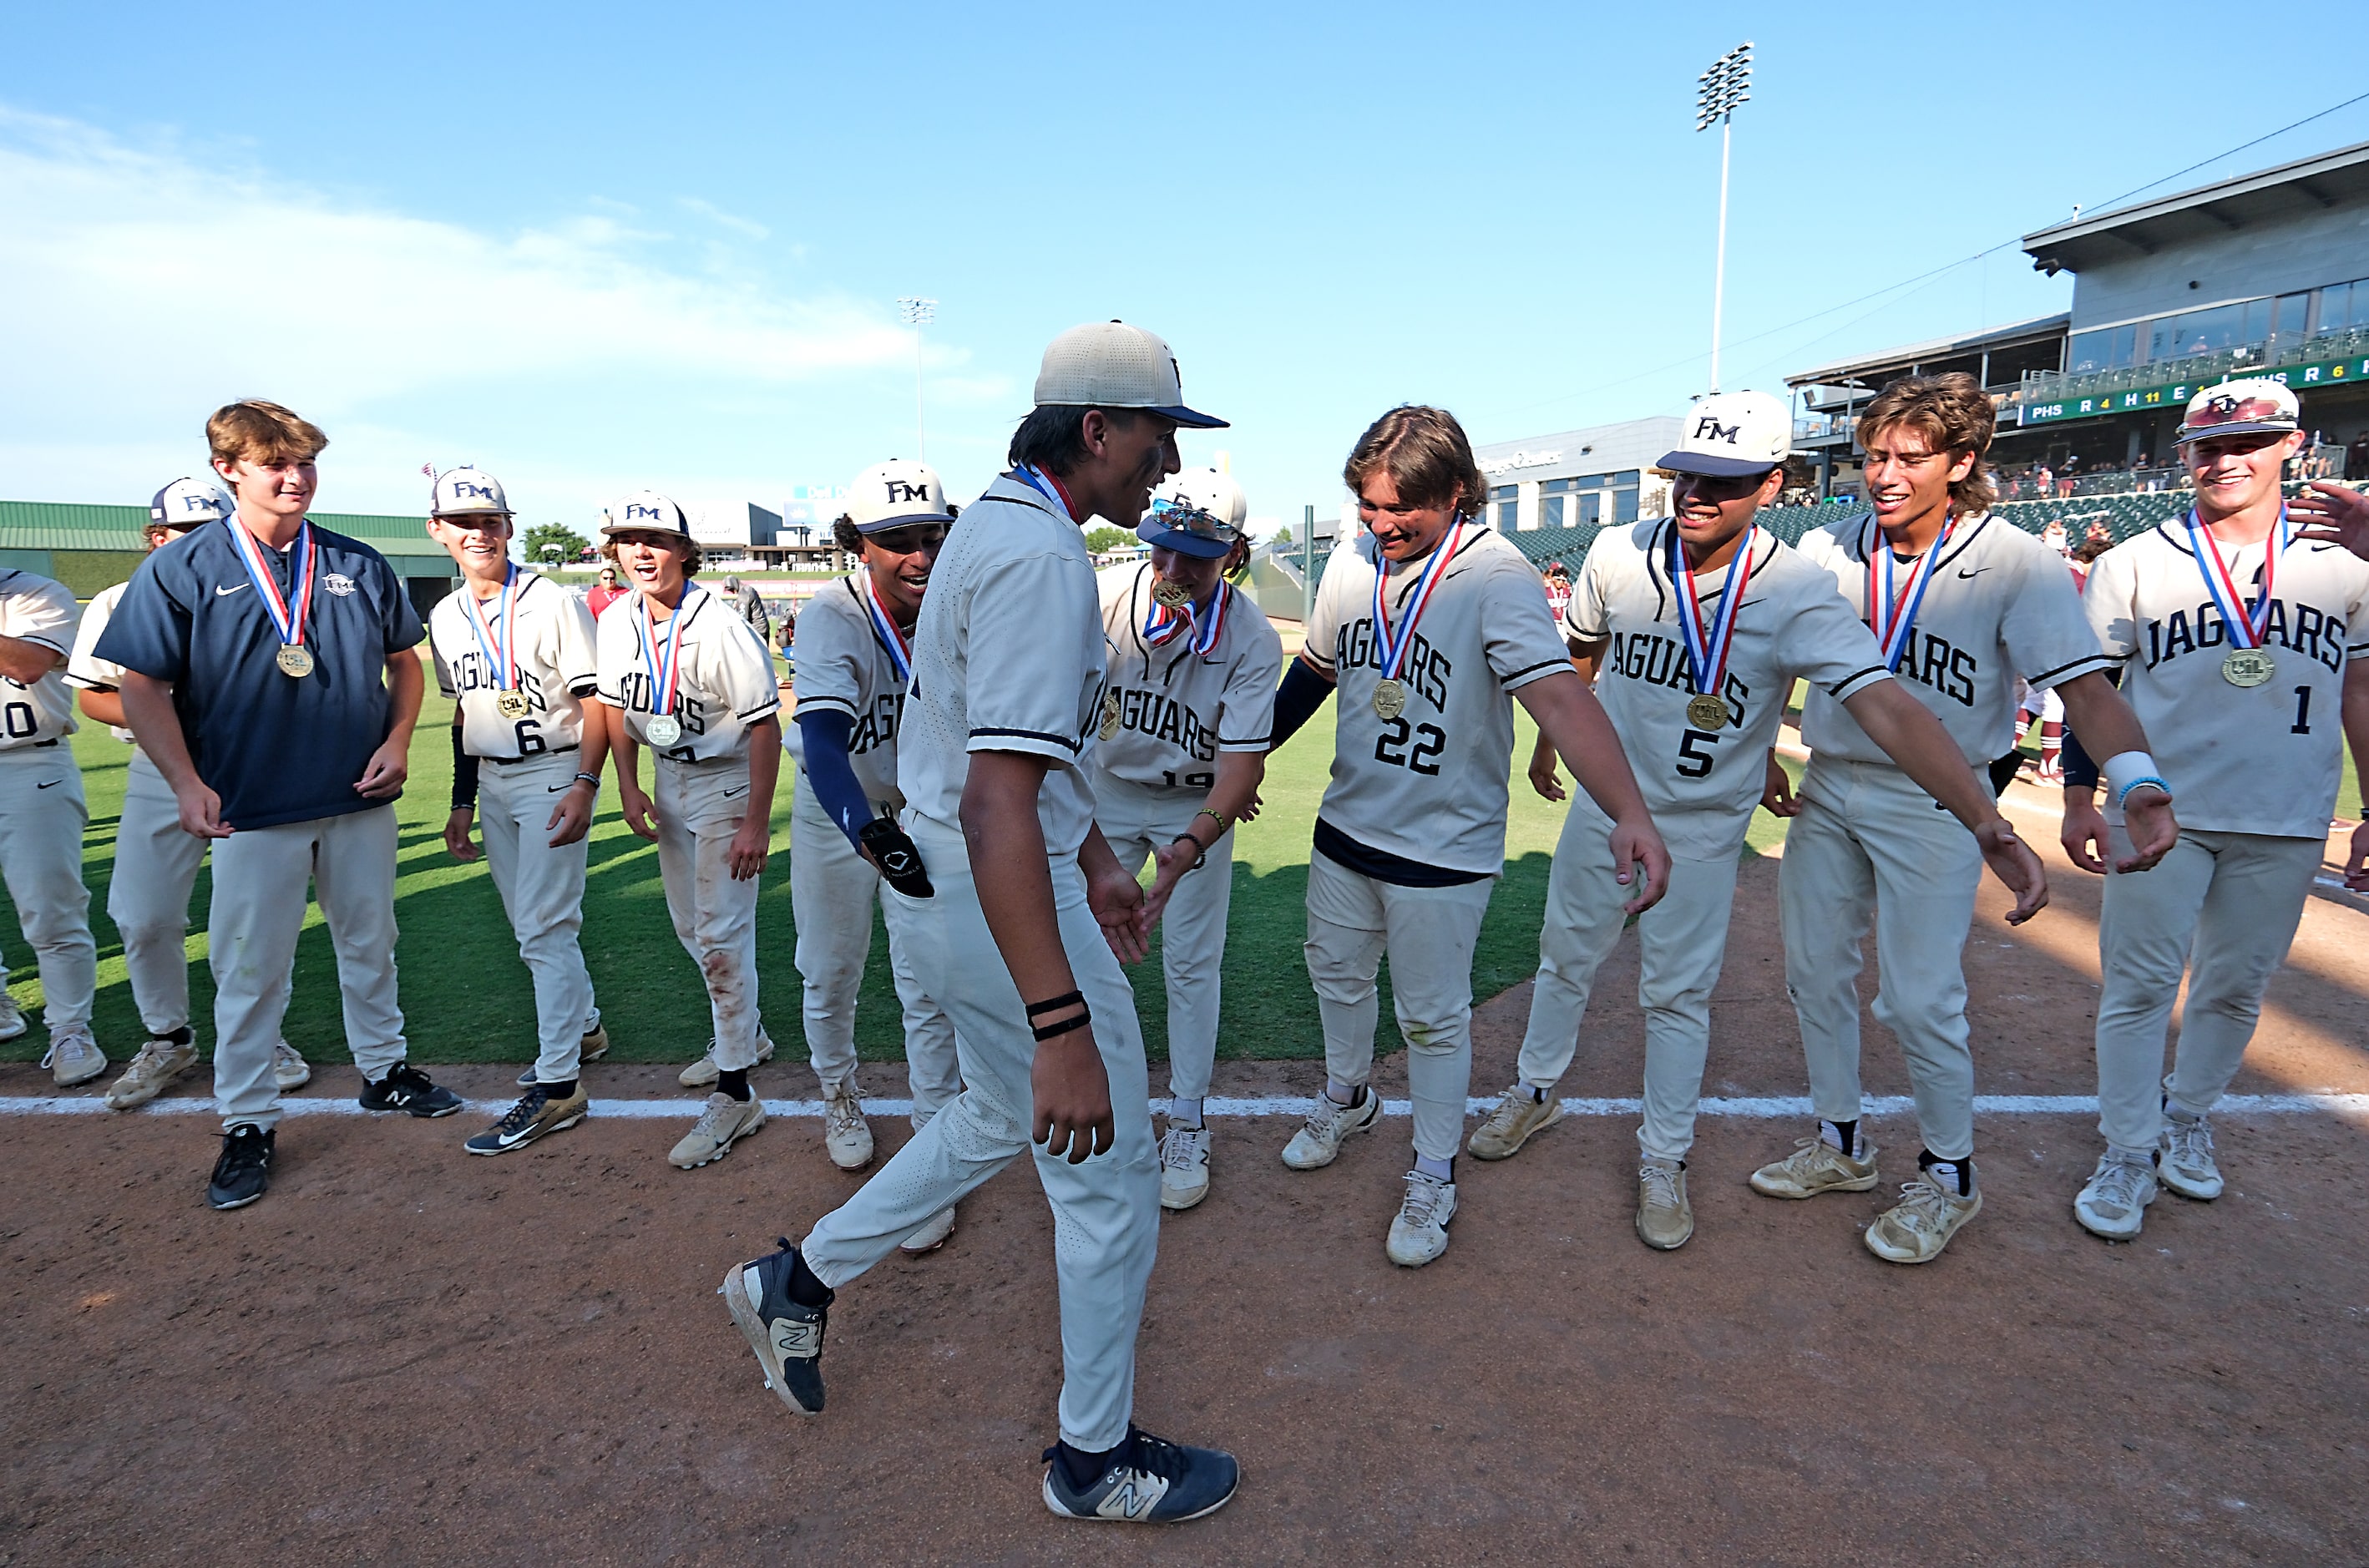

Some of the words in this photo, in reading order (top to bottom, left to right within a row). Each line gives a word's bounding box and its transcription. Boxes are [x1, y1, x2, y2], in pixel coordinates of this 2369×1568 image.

[2305, 367, 2319, 382] R
[2333, 366, 2344, 377] 6
[2032, 405, 2063, 418] PHS
[2080, 400, 2092, 412] R
[2100, 398, 2110, 409] 4
[2124, 393, 2138, 406] H
[2145, 392, 2160, 402] 11
[2173, 387, 2185, 400] E
[1693, 417, 1742, 444] FM
[183, 495, 225, 512] FM
[453, 482, 494, 500] FM
[884, 480, 930, 503] FM
[625, 503, 661, 521] FM
[1612, 632, 1749, 728] AGUAS
[0, 702, 38, 738] 0
[2291, 685, 2311, 734] 1
[515, 720, 546, 756] 6
[1375, 716, 1446, 776] 22
[1676, 729, 1720, 777] 5
